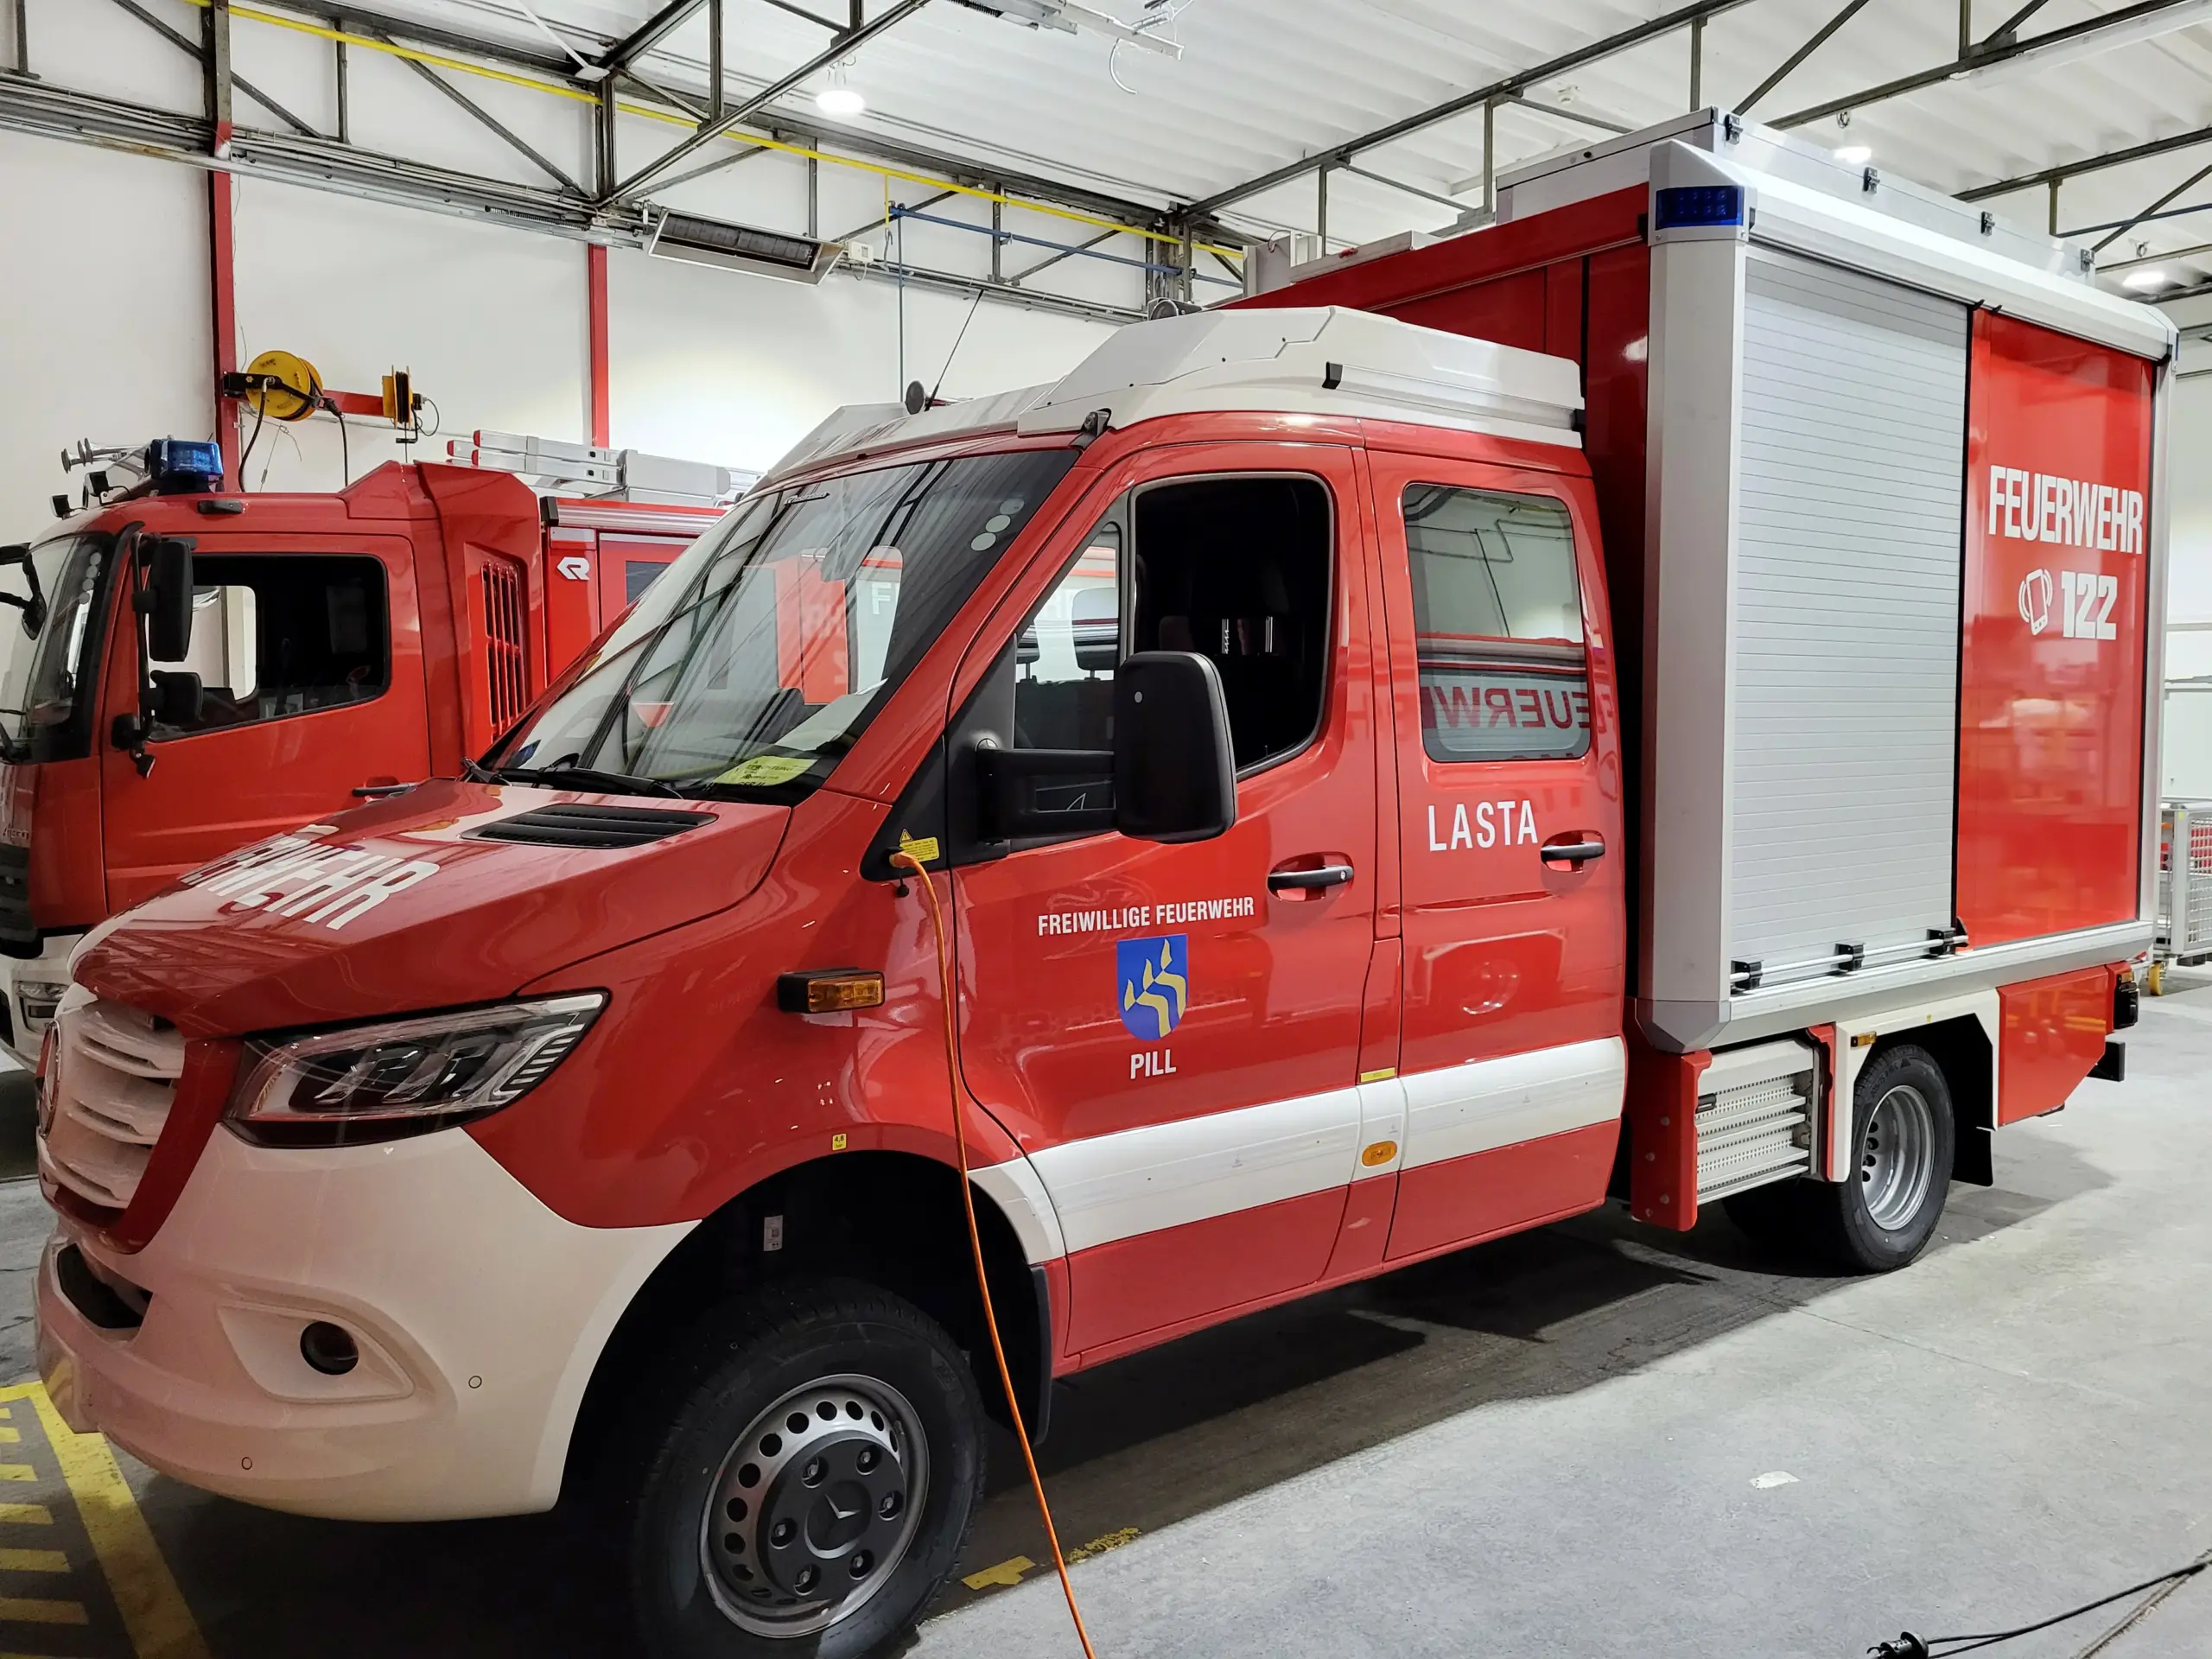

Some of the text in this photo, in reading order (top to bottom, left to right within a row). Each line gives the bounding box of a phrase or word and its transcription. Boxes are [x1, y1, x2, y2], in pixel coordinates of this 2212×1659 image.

[1988, 465, 2143, 555] FEUERWEHR
[2061, 570, 2118, 640] 122
[1428, 799, 1538, 852] LASTA
[1038, 897, 1254, 936] FREIWILLIGE FEUERWEHR
[1130, 1049, 1177, 1079] PILL
